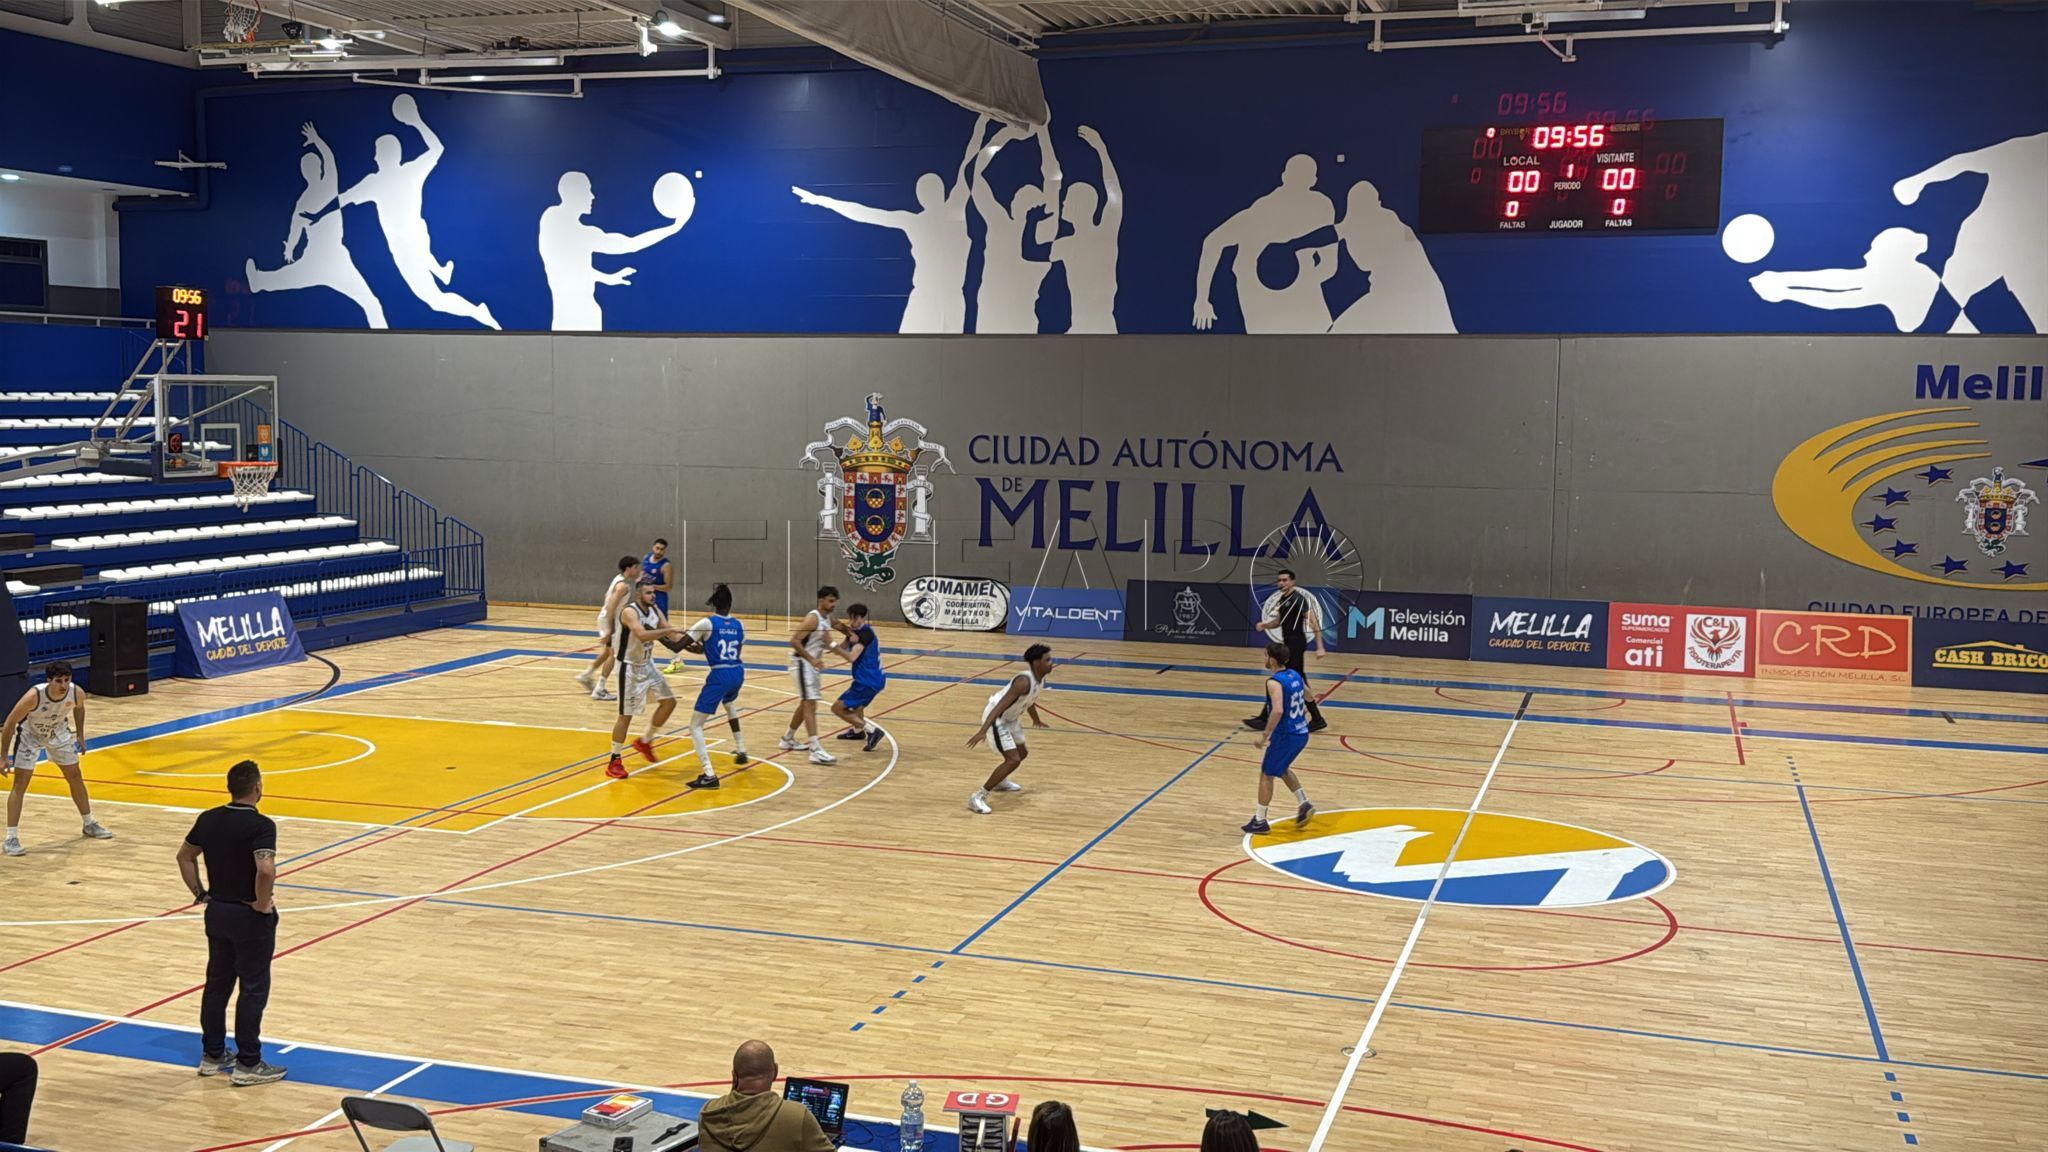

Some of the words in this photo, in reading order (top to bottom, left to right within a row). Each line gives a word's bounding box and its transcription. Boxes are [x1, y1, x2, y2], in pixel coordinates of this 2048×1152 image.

[1534, 125, 1604, 149] 09:56
[1503, 156, 1541, 166] LOCAL
[1597, 152, 1635, 163] VISITANTE
[1566, 163, 1575, 179] 1
[1602, 168, 1636, 190] 00
[1508, 170, 1541, 193] 00
[1554, 181, 1581, 190] PERIODO
[1506, 201, 1519, 217] 0
[1613, 198, 1626, 215] 0
[1500, 221, 1526, 229] FALTAS
[1549, 219, 1583, 229] JUGADOR
[1605, 219, 1632, 227] FALTAS
[174, 309, 203, 338] 21
[1916, 364, 2044, 400] Melil
[968, 434, 1100, 466] CIUDAD
[1112, 431, 1344, 473] AUTÓNOMA
[1002, 477, 1023, 492] DE
[975, 477, 1346, 561] MELILLA
[916, 579, 998, 598] COMAMEL
[946, 600, 990, 609] COOPERATIVA
[944, 609, 990, 617] MAESTROS
[1015, 605, 1122, 621] VITALDENT
[1389, 608, 1465, 626] Televisión
[1621, 613, 1671, 627] suma
[196, 606, 286, 648] MELILLA
[1489, 611, 1593, 639] MELILLA
[1703, 616, 1729, 629] C&L
[1390, 626, 1449, 642] Melilla
[1625, 636, 1664, 645] Comercial
[1772, 620, 1897, 659] CRD
[238, 643, 256, 656] DEL
[717, 638, 739, 660] 25
[1488, 638, 1524, 649] CIUDAD
[1526, 639, 1544, 650] DEL
[1547, 641, 1592, 652] DEPORTE
[1625, 646, 1664, 667] ati
[1687, 646, 1744, 669] FISIOTERAPEUTA
[1934, 648, 1985, 665] CASH
[1991, 651, 2048, 669] BRICO
